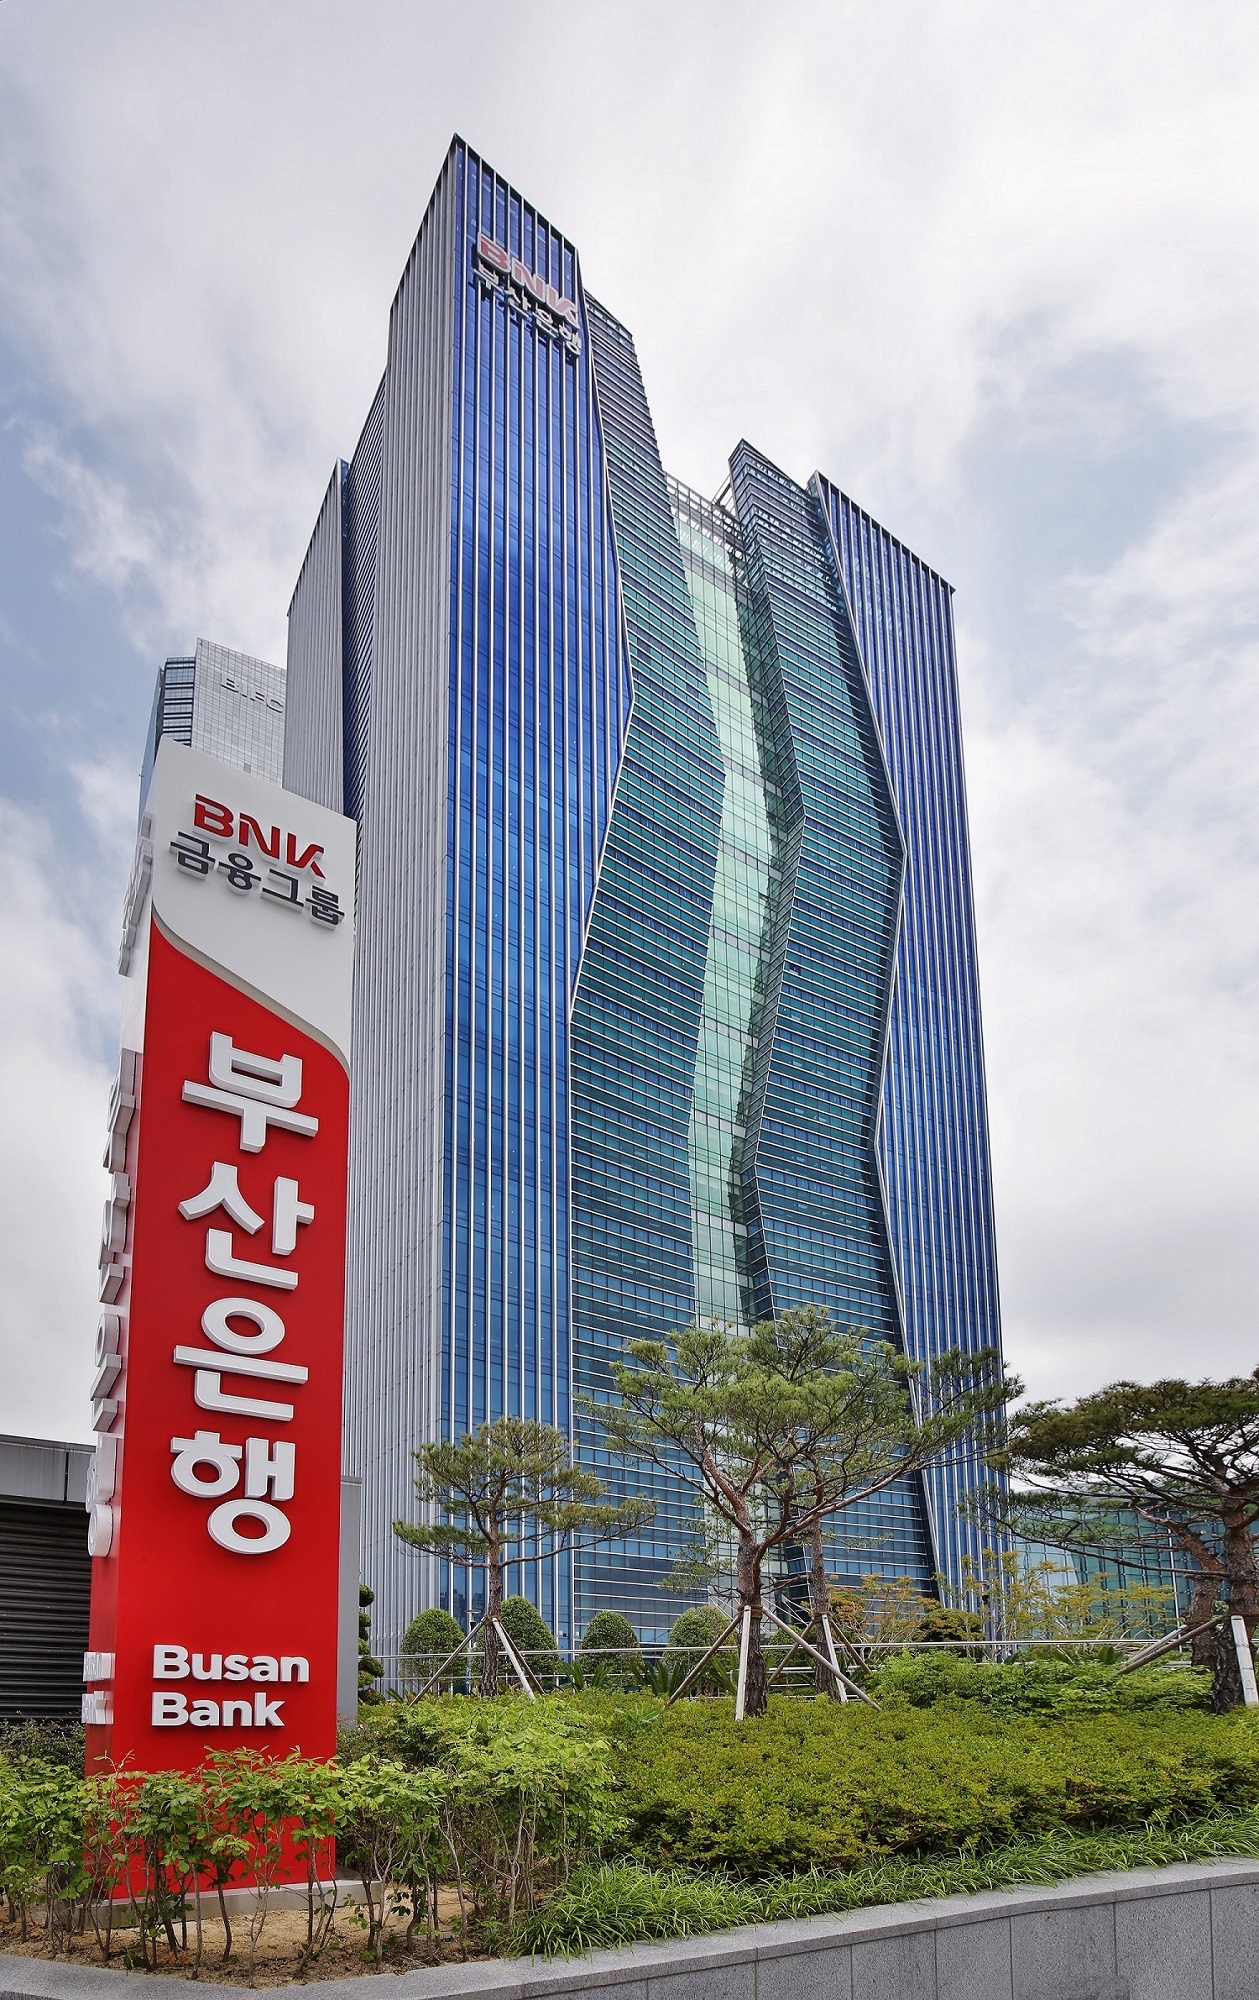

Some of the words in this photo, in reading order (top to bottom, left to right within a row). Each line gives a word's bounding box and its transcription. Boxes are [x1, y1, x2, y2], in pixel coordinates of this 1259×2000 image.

[473, 262, 582, 356] 부산은행
[477, 231, 580, 330] BNK
[220, 672, 284, 713] BIFC
[169, 831, 345, 930] 금융그룹
[193, 793, 326, 882] BNK
[169, 1030, 319, 1555] 부산은행
[153, 1644, 309, 1682] Busan
[151, 1691, 285, 1727] Bank
